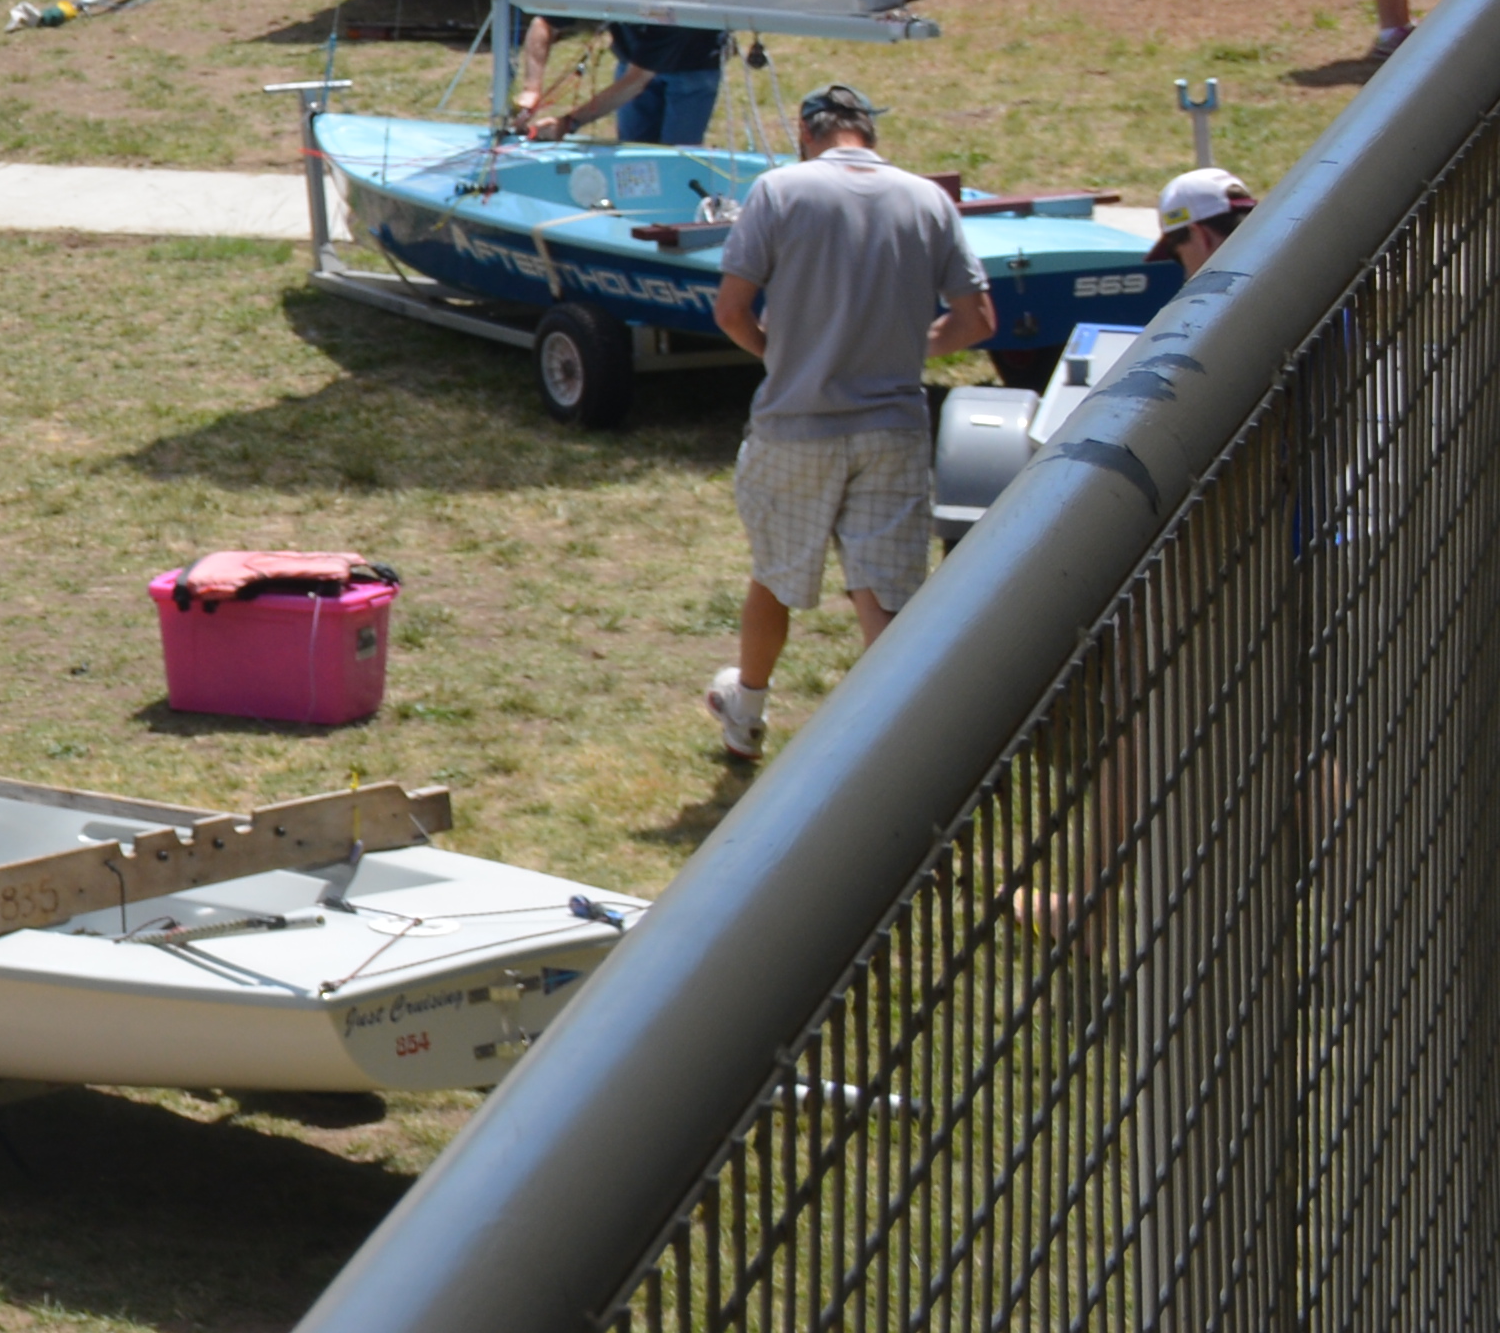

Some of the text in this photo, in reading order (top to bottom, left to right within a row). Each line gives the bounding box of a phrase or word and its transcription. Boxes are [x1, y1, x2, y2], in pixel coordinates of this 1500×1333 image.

[1074, 274, 1149, 297] 569
[345, 989, 464, 1038] Just Cruising
[396, 1031, 432, 1056] 854
